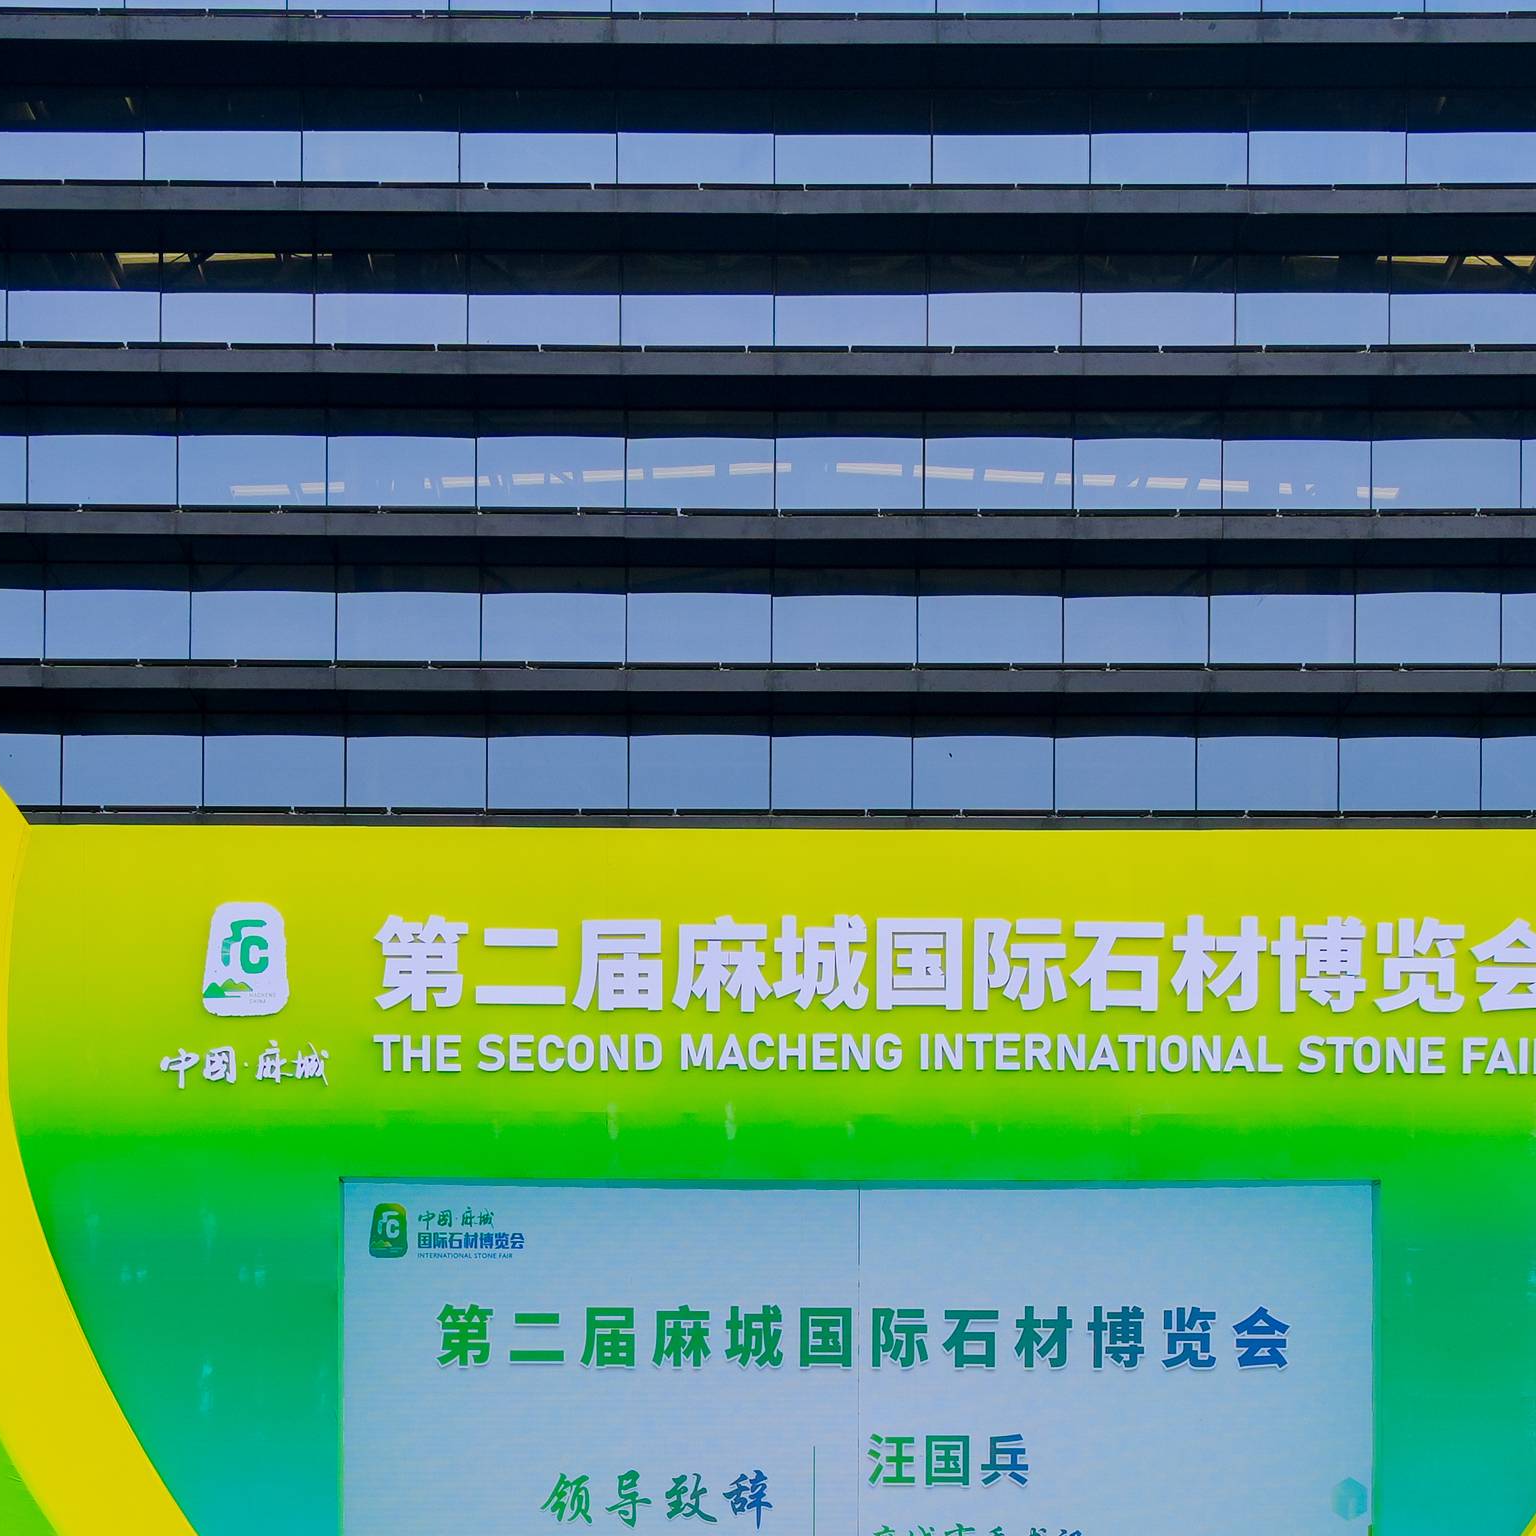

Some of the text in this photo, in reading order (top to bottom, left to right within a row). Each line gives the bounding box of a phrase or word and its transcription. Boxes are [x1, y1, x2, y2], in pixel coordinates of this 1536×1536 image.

[373, 1034, 461, 1071] THE
[478, 1033, 662, 1071] SECOND
[681, 1033, 903, 1070] MACHENG
[920, 1033, 1284, 1072] INTERNATIONAL
[1298, 1035, 1446, 1073] STONE
[417, 1232, 525, 1250] 国际石材博览会
[417, 1252, 513, 1260] INTERNATIONAL STONE FAIR
[436, 1303, 1291, 1372] 第二届麻城国际石材博览会
[867, 1433, 1029, 1487] 汪国兵
[540, 1470, 774, 1530] 领导致辞
